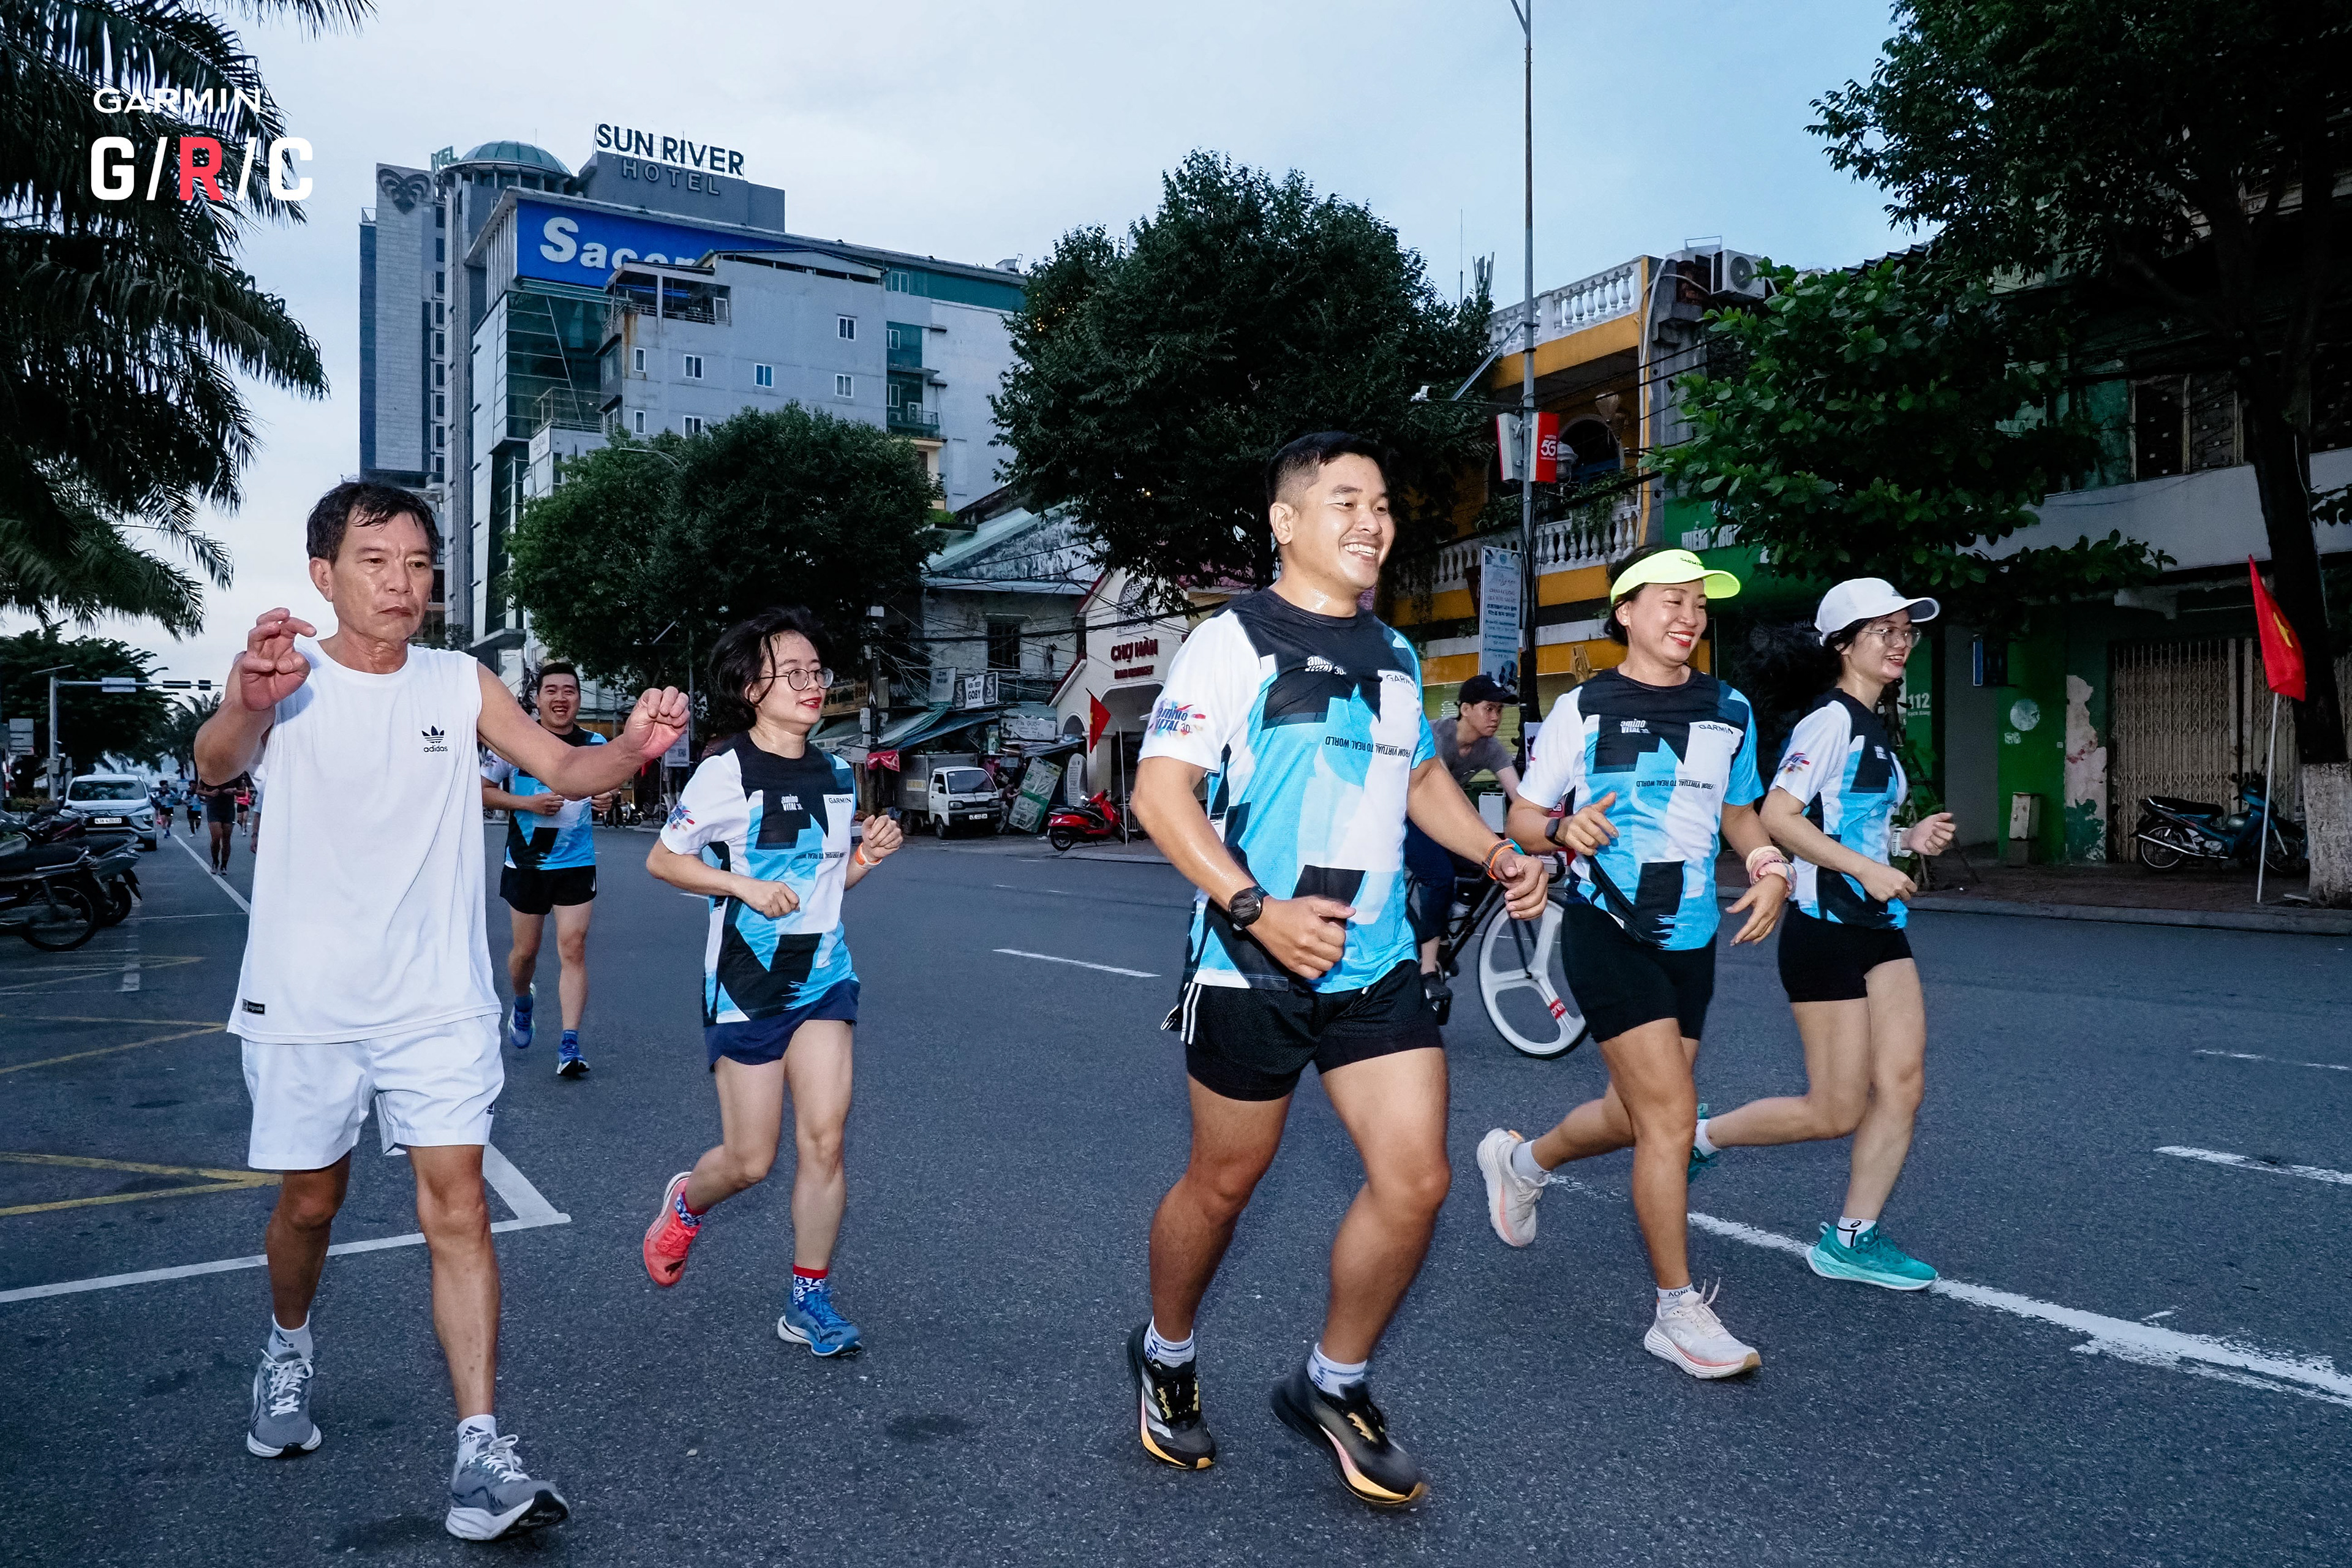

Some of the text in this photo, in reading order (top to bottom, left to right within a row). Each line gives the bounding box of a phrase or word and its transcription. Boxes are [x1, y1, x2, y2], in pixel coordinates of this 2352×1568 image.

[596, 123, 744, 176] SUN RIVER
[622, 158, 720, 195] HOTEL
[1540, 439, 1556, 456] 5G
[1110, 636, 1158, 663] CHỢ HÀN
[1908, 693, 1930, 709] 112
[1620, 718, 1646, 728] amino
[1698, 723, 1733, 734] GARMIN
[1325, 736, 1349, 748] WORLD
[1352, 741, 1366, 750] REAL
[1366, 743, 1374, 752] TO
[1376, 745, 1398, 756] VIRTUAL
